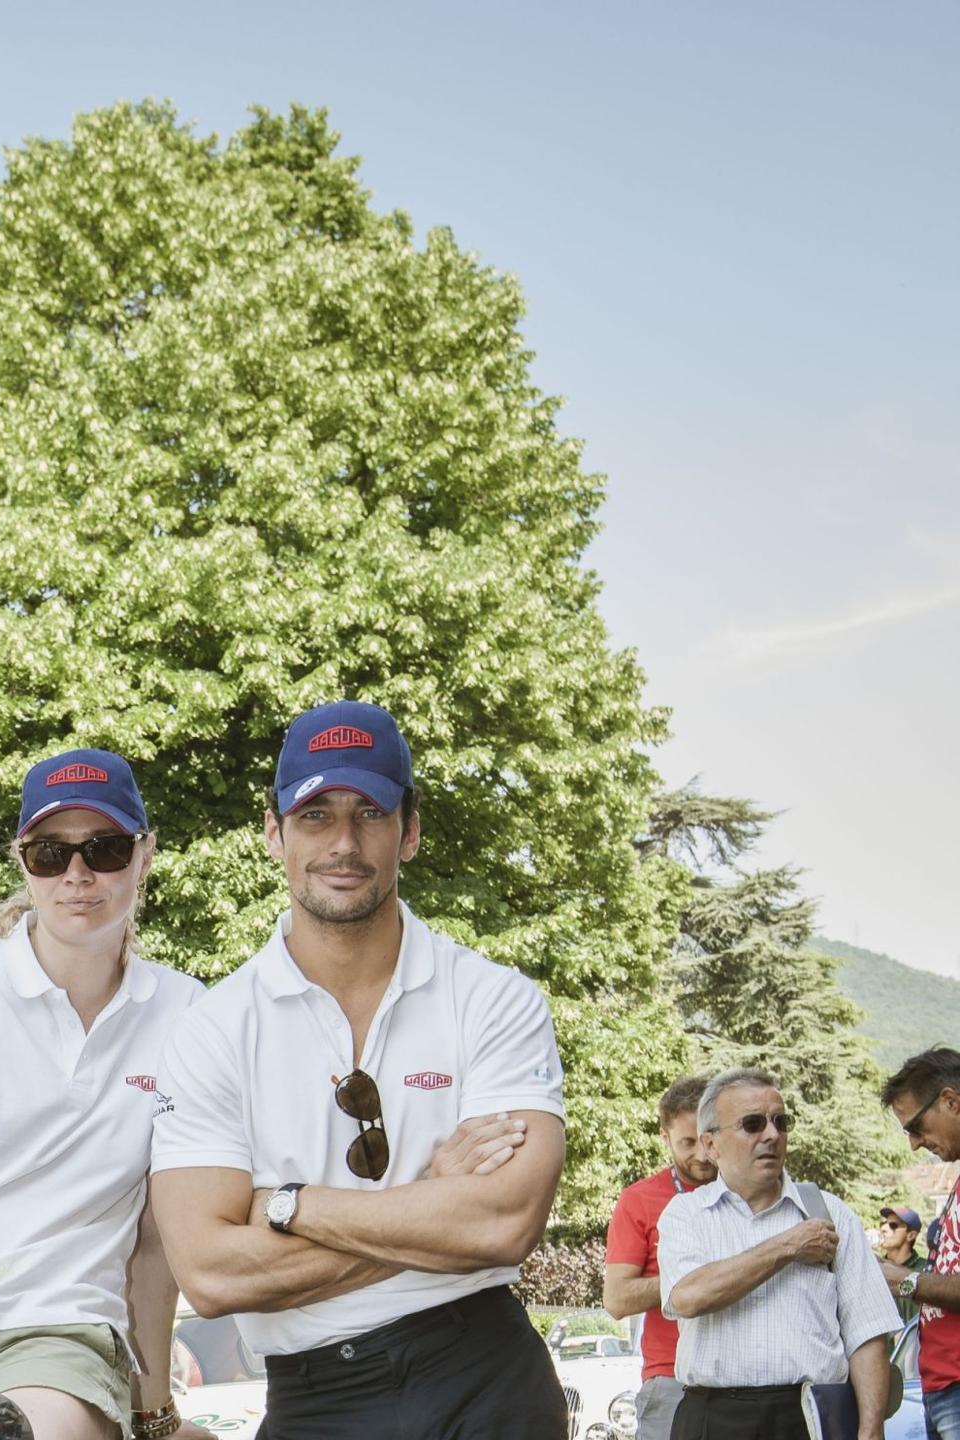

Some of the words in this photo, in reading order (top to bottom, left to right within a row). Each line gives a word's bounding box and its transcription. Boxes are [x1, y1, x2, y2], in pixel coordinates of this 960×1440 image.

[310, 728, 370, 748] JAGUAR
[48, 765, 106, 783] JAGUAR
[127, 1077, 156, 1090] JAGU
[405, 1074, 451, 1088] JAGUAR
